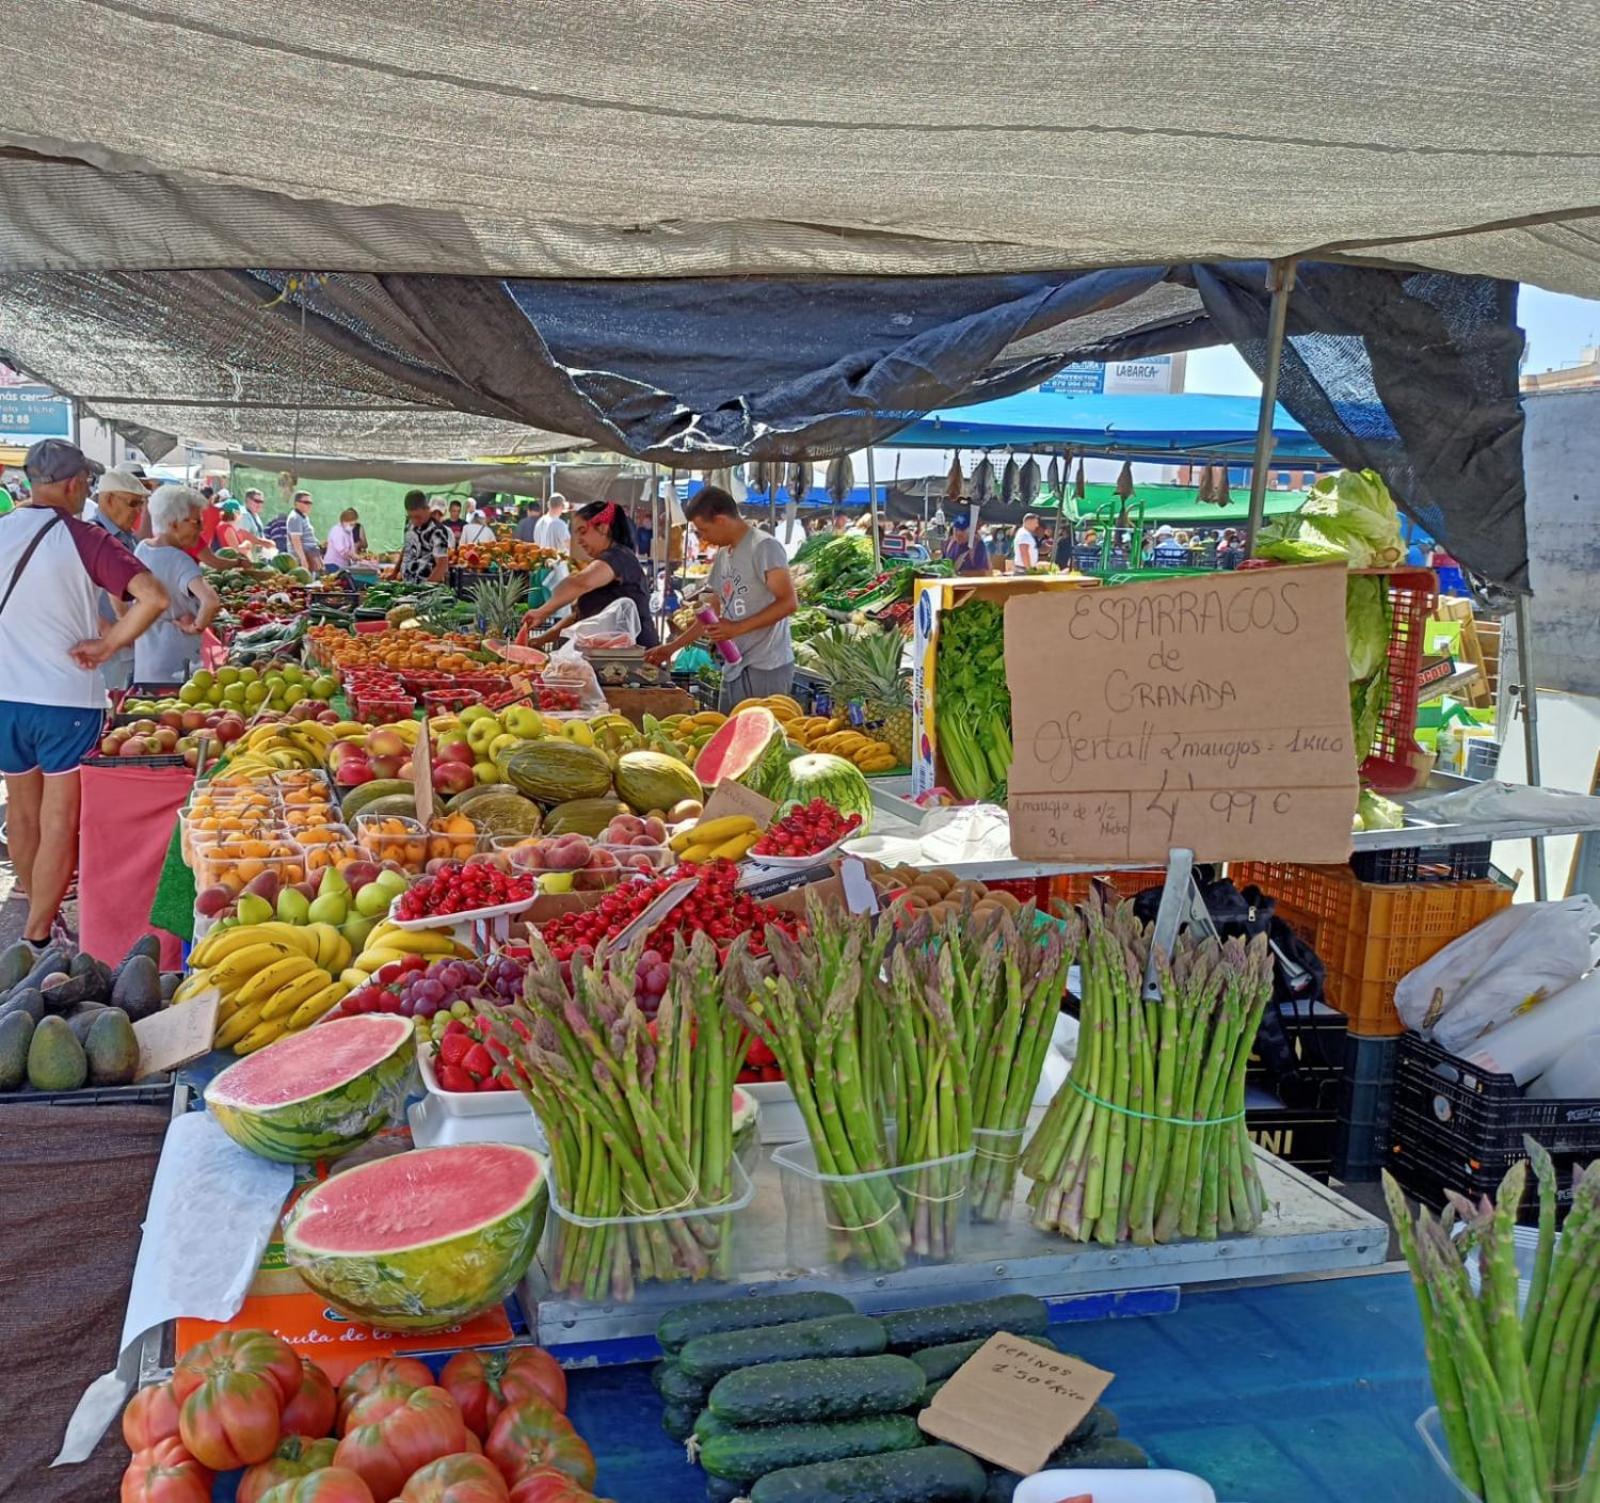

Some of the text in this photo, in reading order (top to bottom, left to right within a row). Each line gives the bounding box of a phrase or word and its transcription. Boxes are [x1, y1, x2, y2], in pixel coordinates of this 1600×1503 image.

[734, 598, 746, 617] 6
[1068, 582, 1299, 643] ESPARRAGOS
[1148, 640, 1184, 672] de
[1104, 668, 1237, 713] GRANADA
[1073, 802, 1087, 820] de
[339, 1327, 367, 1342] de
[995, 1343, 1072, 1376] PEPINOS
